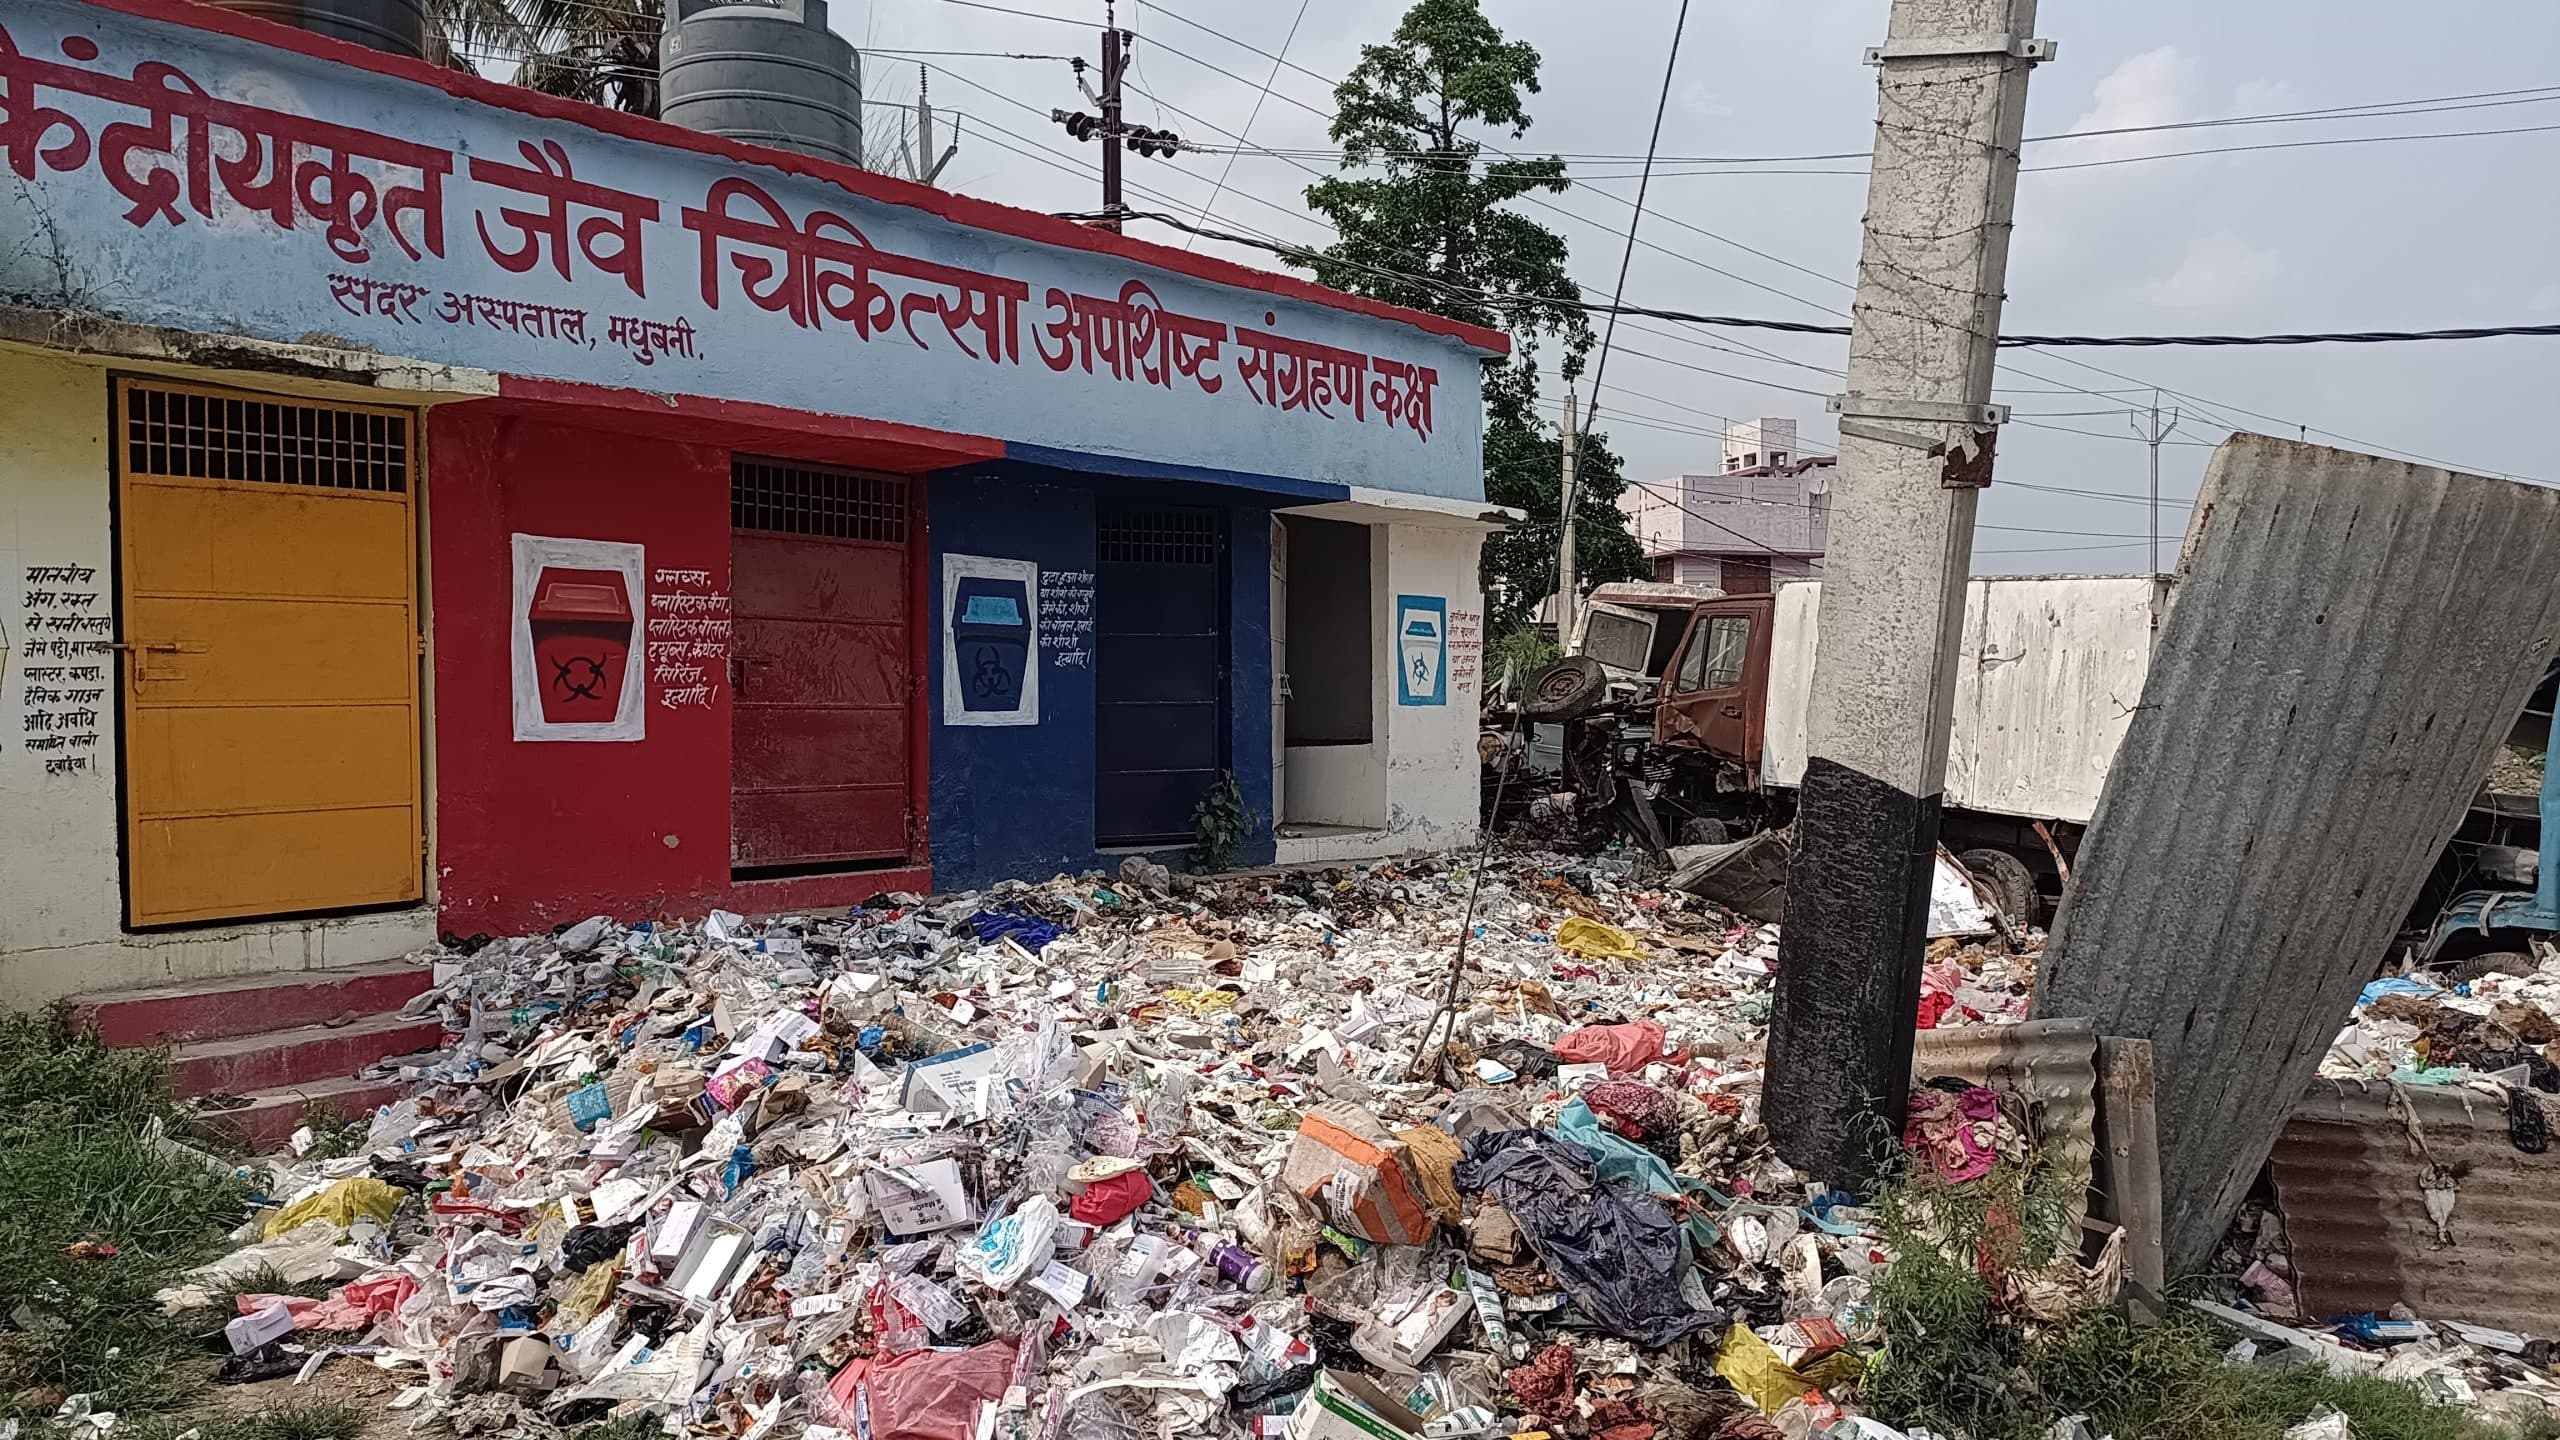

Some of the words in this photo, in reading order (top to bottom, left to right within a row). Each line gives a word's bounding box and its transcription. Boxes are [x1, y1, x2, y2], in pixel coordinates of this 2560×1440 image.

[469, 138, 660, 298] जैव
[682, 176, 1028, 366] चिकित्सा
[1033, 279, 1227, 394] अपशिष्ट
[1234, 311, 1367, 422] संग्रहण
[1370, 356, 1439, 442] कक्ष
[327, 272, 431, 325] सदर
[435, 291, 597, 350] अस्पताल,
[26, 562, 96, 586] मानवीय
[25, 612, 43, 635] से
[22, 636, 48, 660] जैसे
[64, 688, 104, 705] गाउन
[23, 709, 54, 733] आदि
[55, 707, 98, 731] अवधि
[69, 731, 100, 752] वाली
